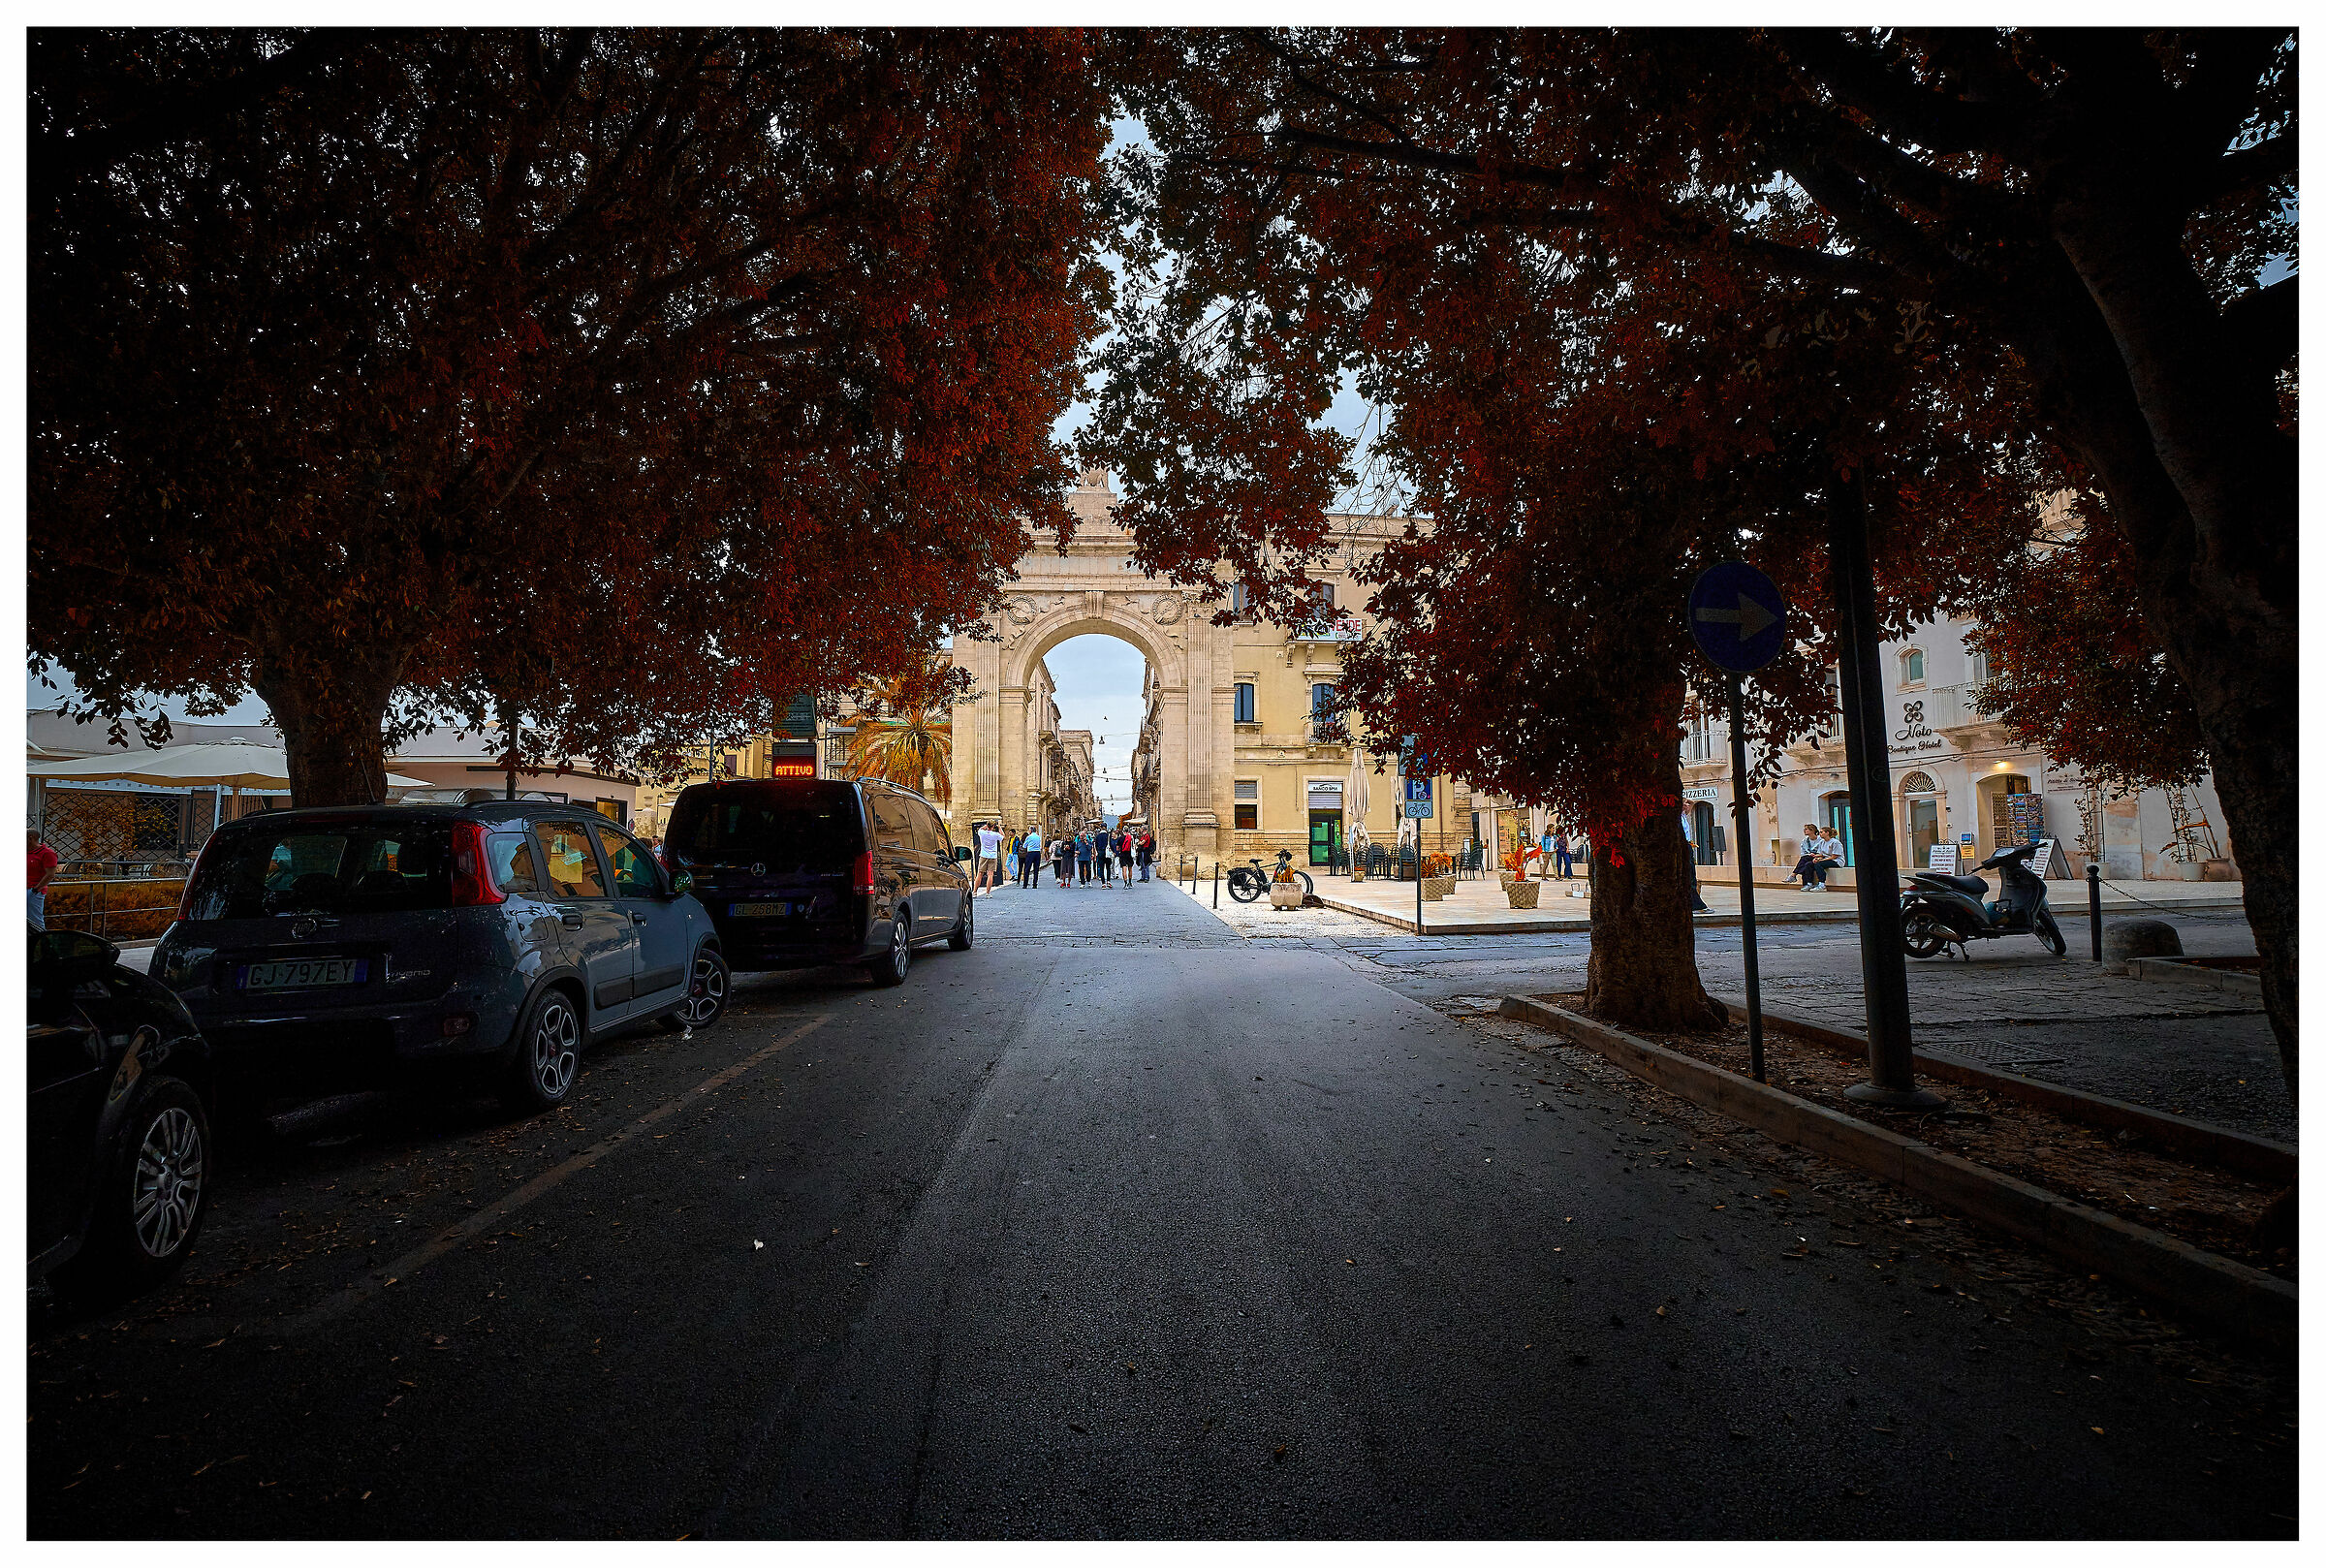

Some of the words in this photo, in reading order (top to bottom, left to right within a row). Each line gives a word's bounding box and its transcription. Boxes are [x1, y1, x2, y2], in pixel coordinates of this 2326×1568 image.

[1895, 724, 1932, 740] Noto
[1918, 738, 1942, 750] Hotel
[775, 766, 813, 775] ATTIVO
